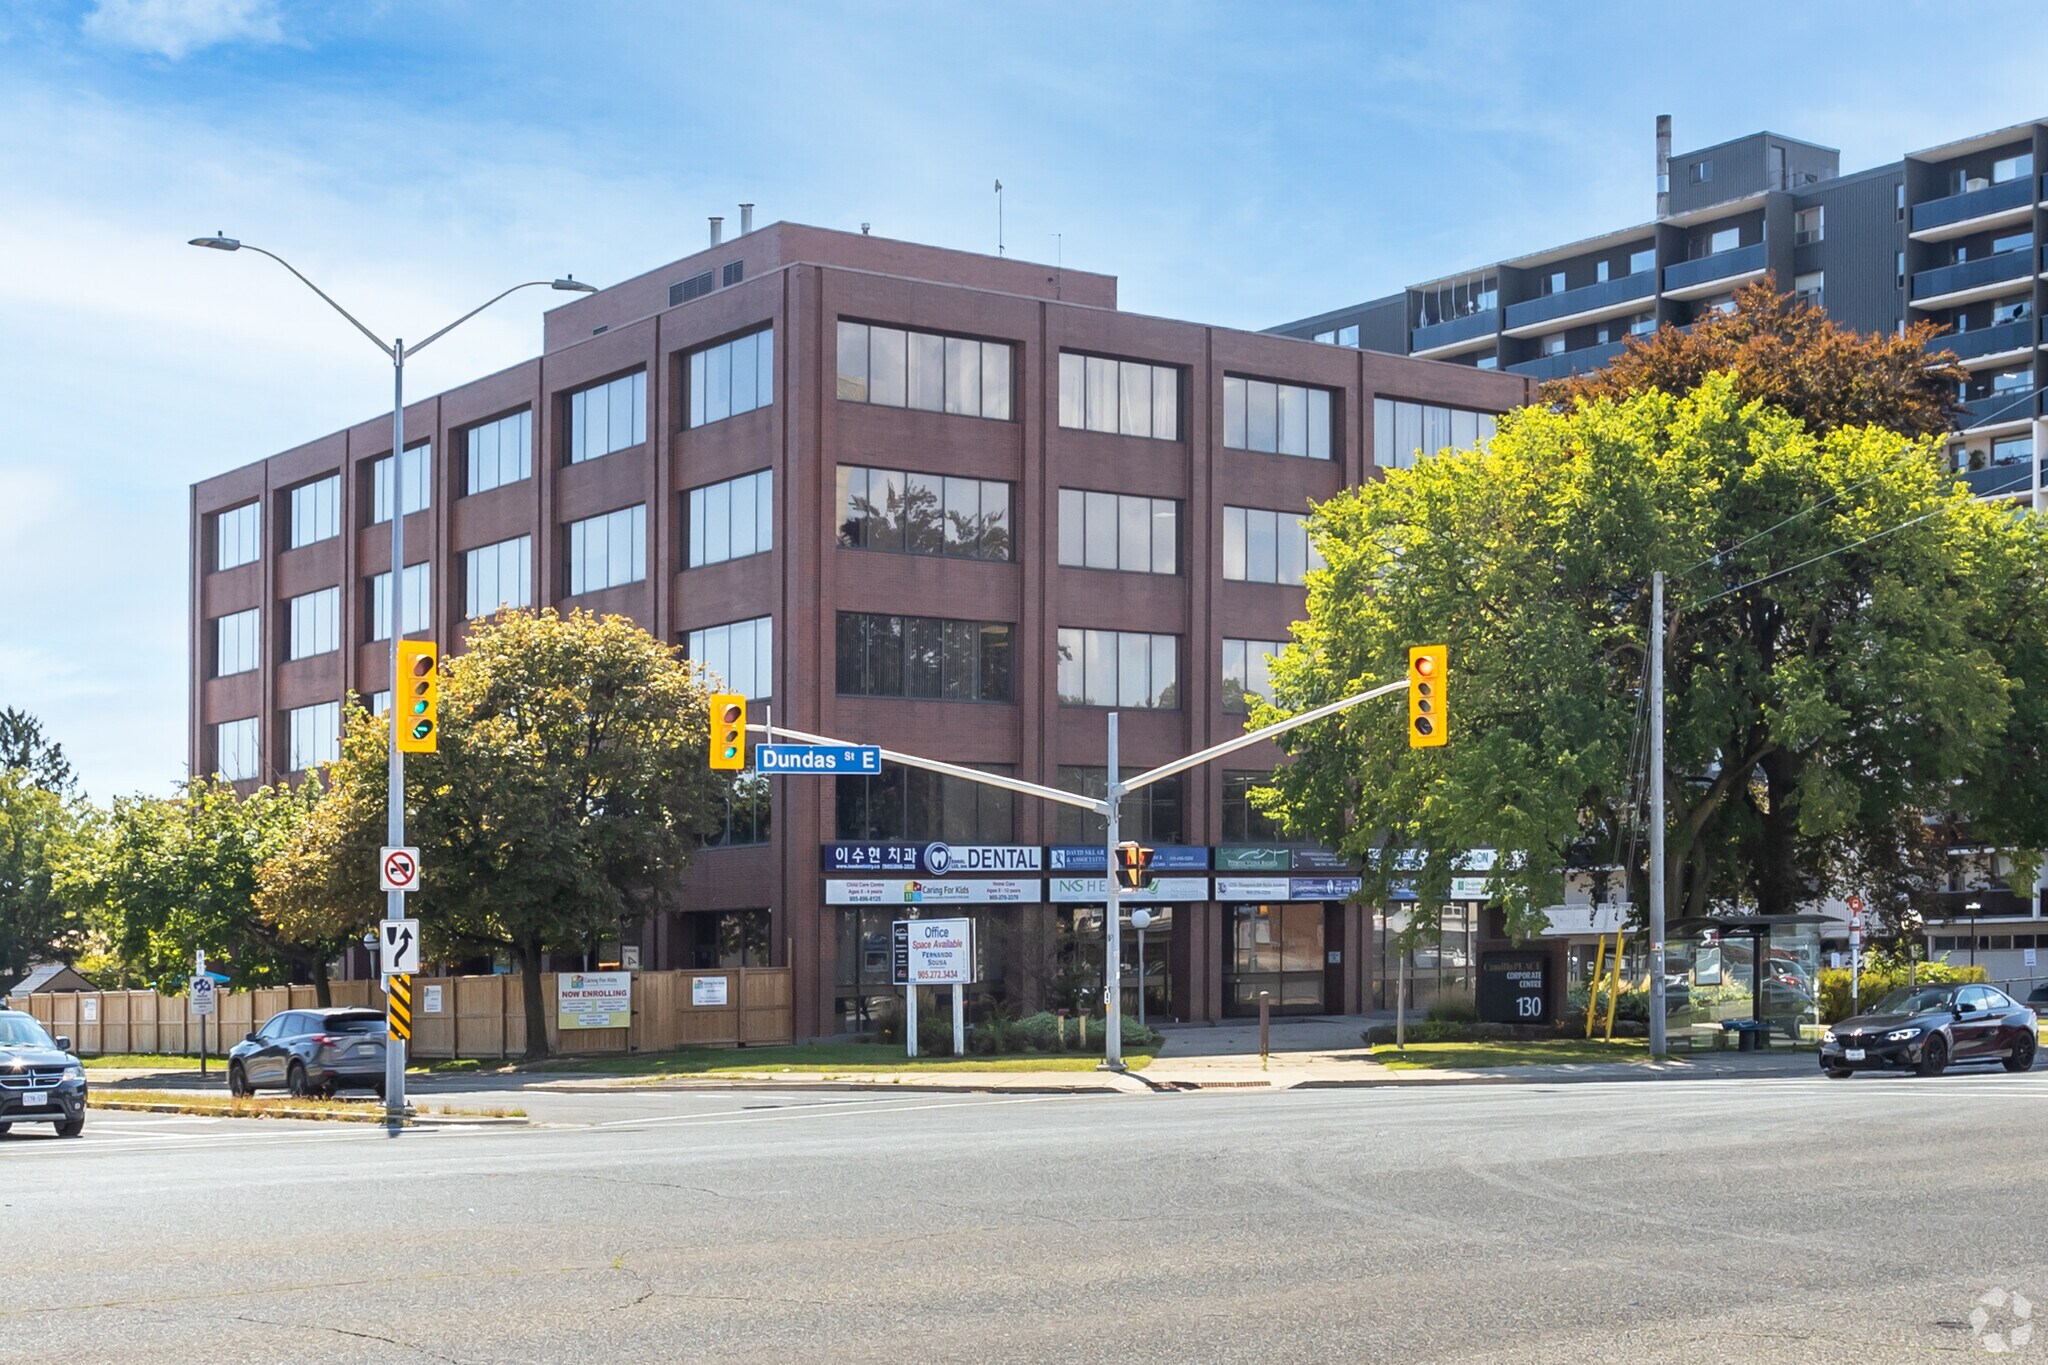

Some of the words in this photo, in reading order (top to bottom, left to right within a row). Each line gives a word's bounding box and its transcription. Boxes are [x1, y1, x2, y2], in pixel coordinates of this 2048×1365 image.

[763, 749, 836, 769] Dundas
[844, 750, 856, 761] St
[862, 751, 875, 769] E
[835, 846, 880, 864] 이수현
[887, 846, 917, 864] 치과
[968, 848, 1039, 869] DENTAL
[922, 886, 942, 896] Caring
[943, 885, 954, 894] For
[955, 885, 969, 894] Kids
[1060, 879, 1084, 892] NKS
[925, 926, 949, 938] Office
[912, 940, 931, 951] Space
[933, 939, 963, 949] Available
[922, 951, 953, 959] FERNANDO
[928, 958, 947, 966] SOUSA
[1506, 971, 1542, 980] CORPORATE
[1519, 980, 1542, 988] CENTRE
[562, 990, 580, 998] NOW
[1516, 997, 1542, 1016] 130
